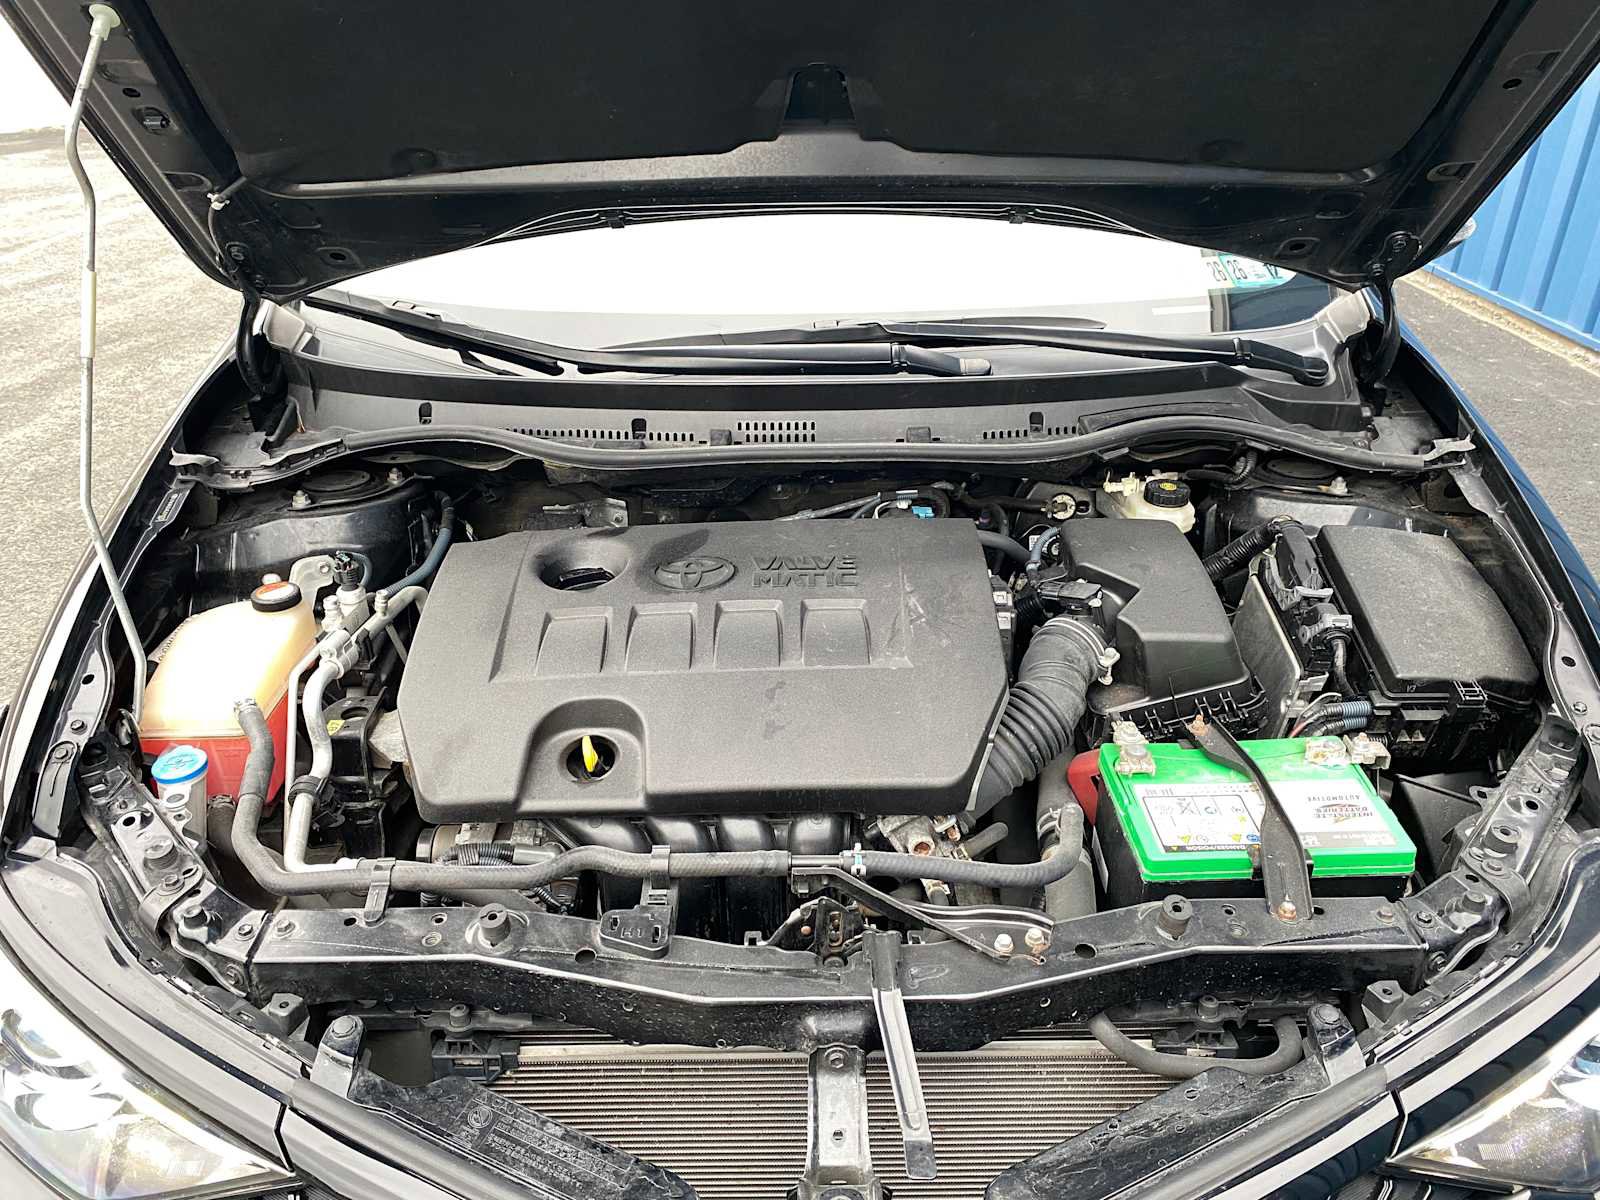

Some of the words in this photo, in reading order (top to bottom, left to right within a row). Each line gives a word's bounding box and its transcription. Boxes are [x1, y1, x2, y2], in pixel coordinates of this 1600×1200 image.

[751, 555, 857, 571] VALVE
[751, 572, 858, 588] MATIC
[1306, 794, 1361, 802] AUTOMOTIVE
